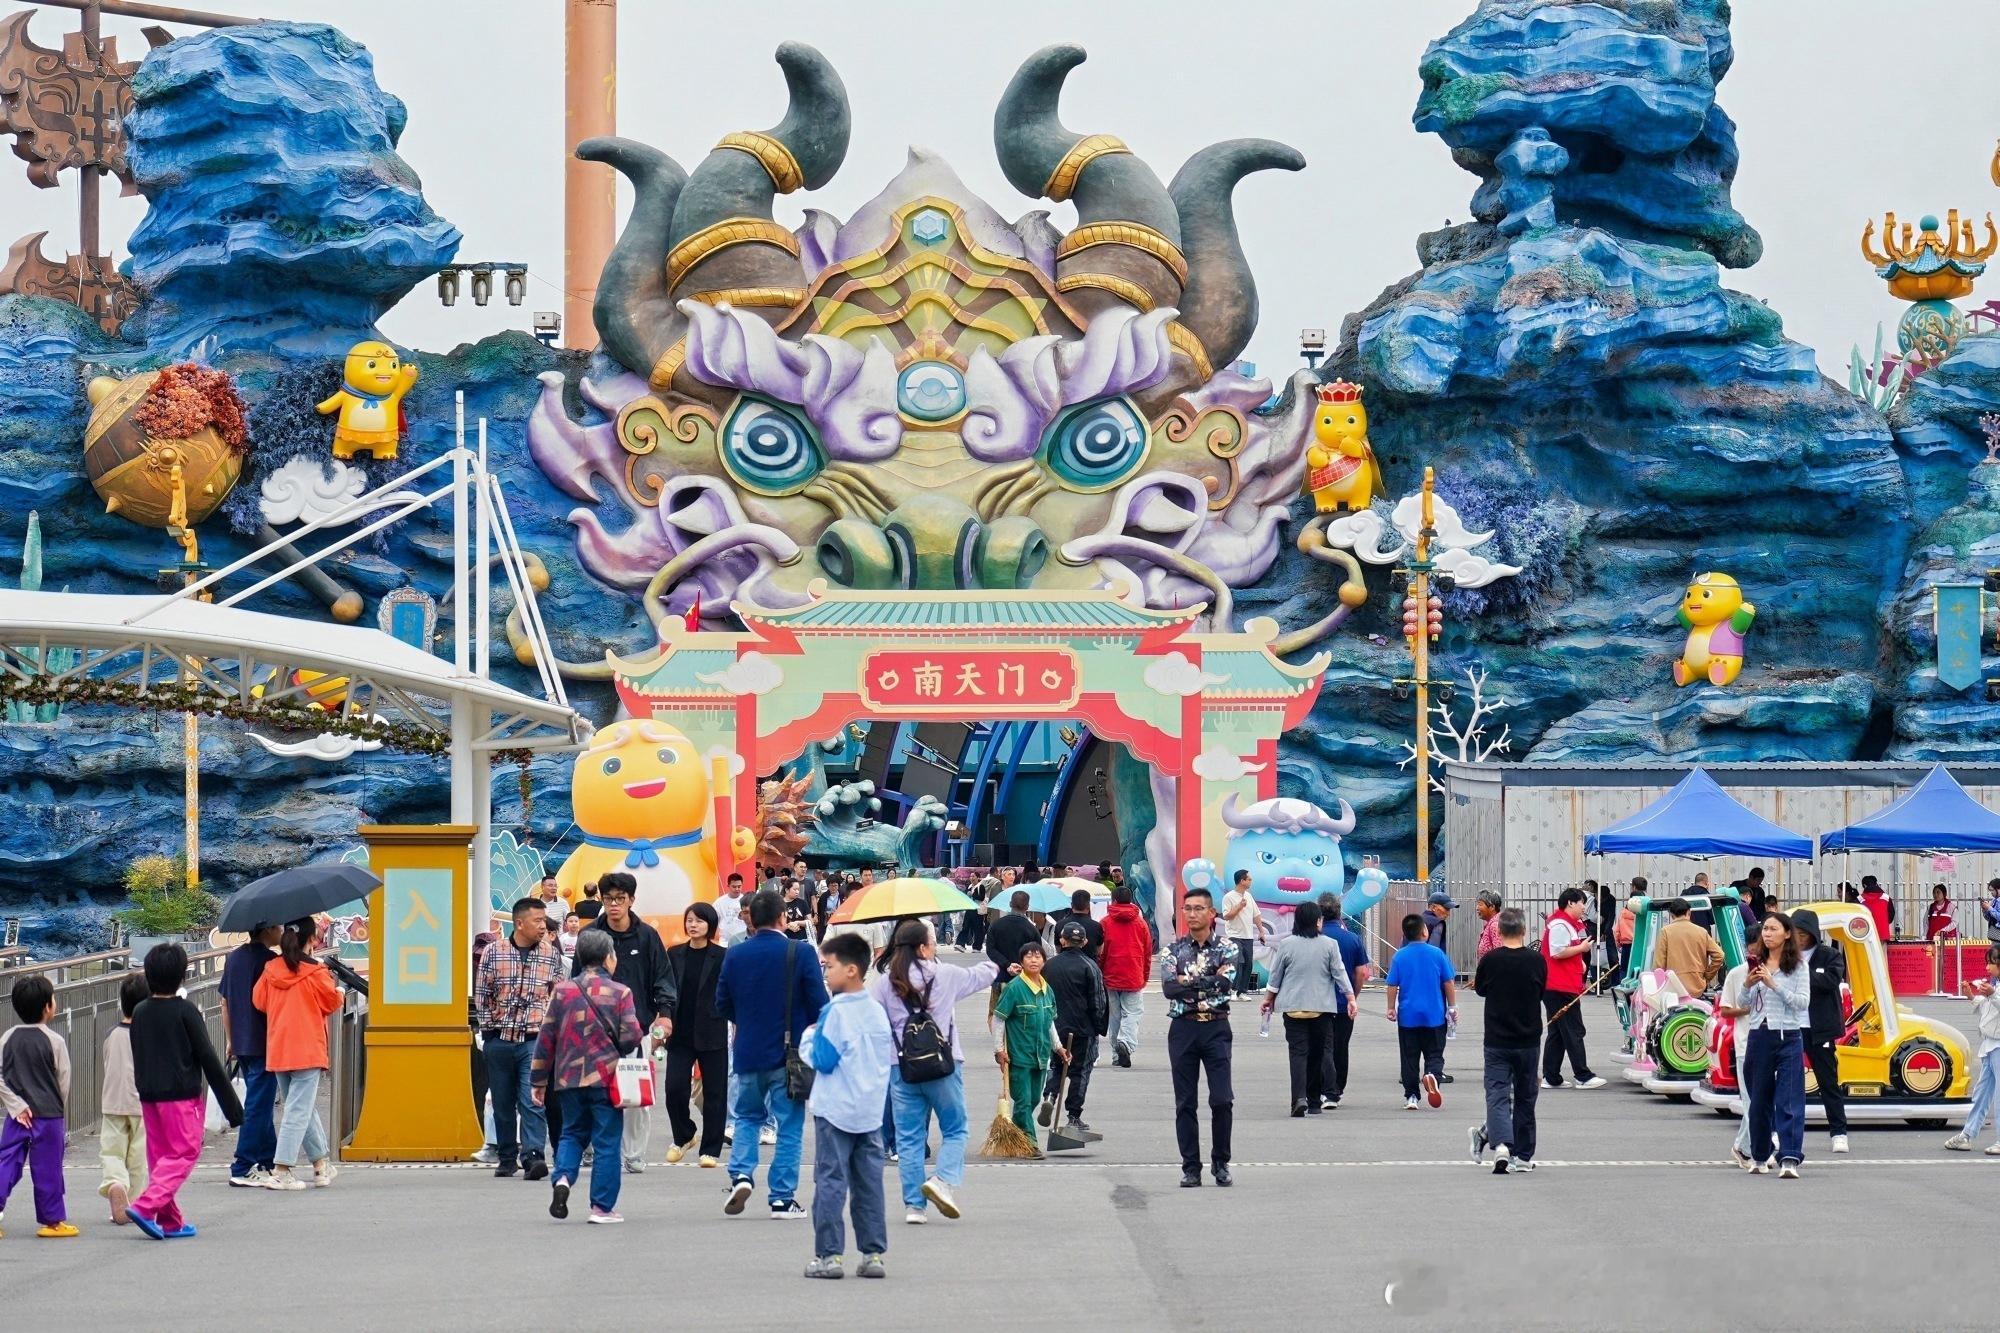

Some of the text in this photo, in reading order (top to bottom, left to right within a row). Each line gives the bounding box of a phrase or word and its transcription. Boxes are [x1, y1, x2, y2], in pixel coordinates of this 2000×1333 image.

[912, 660, 1025, 698] 南天门
[398, 889, 438, 985] 入口
